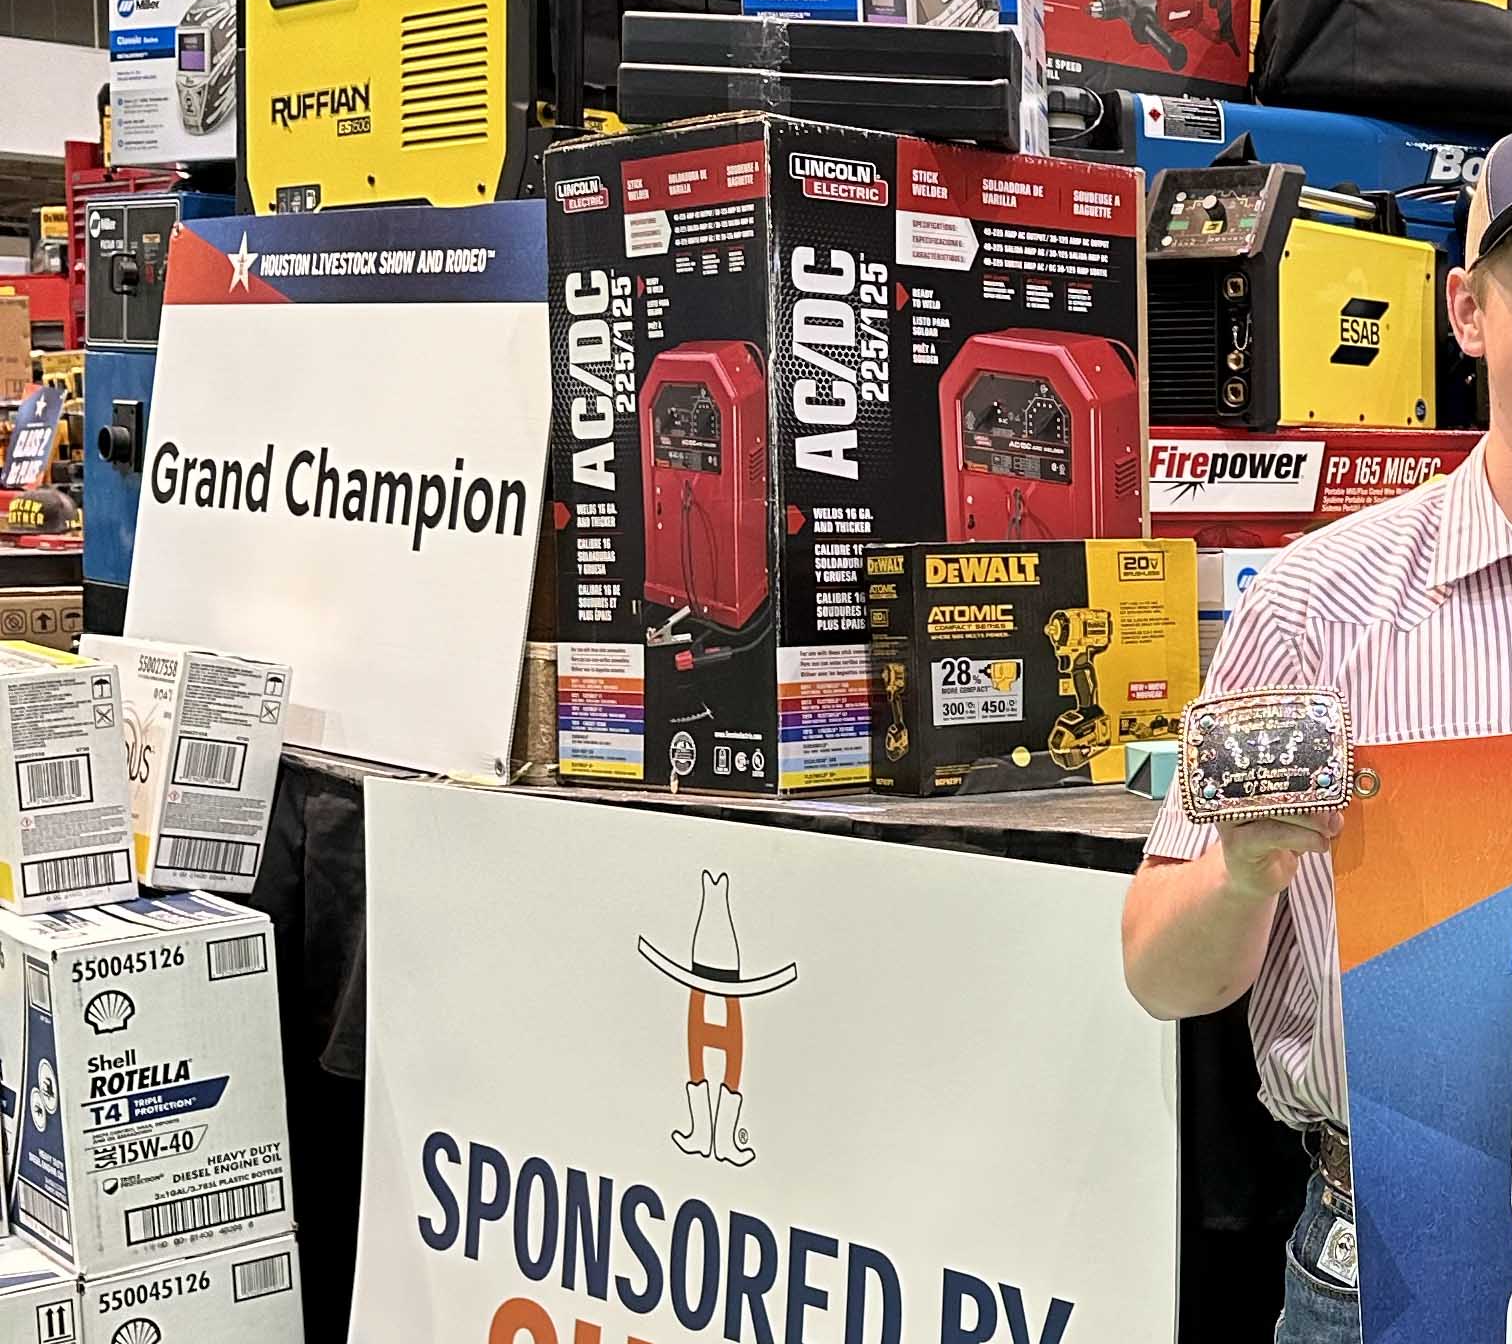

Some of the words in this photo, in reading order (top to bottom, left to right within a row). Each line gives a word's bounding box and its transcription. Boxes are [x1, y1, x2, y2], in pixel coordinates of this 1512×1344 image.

[271, 78, 371, 129] RUFFIAN
[795, 158, 870, 184] LINCOLN
[912, 169, 939, 185] STICK
[558, 180, 598, 197] LINCOLN
[813, 180, 879, 201] ELECTRIC
[912, 183, 948, 200] WELDER
[982, 178, 1031, 197] SOLDADORA
[1032, 186, 1044, 198] DE
[569, 195, 604, 209] ELECTRIC
[982, 192, 1017, 208] VARILLA
[260, 256, 310, 277] HOUSTON
[311, 253, 377, 276] LIVESTOCK
[379, 251, 415, 274] SHOW
[416, 250, 443, 273] AND
[1340, 315, 1380, 344] ESAB
[791, 246, 859, 481] AC/DC
[565, 269, 616, 491] AC/DC
[1150, 445, 1308, 484] Firepower
[1326, 456, 1351, 485] FP
[1354, 456, 1382, 485] 165
[151, 441, 275, 514] Grand
[284, 448, 528, 552] Champion
[813, 507, 844, 522] WELDS
[846, 507, 857, 520] 16
[858, 507, 874, 520] GA.
[813, 521, 833, 533] AND
[834, 521, 871, 534] THICKER
[815, 544, 851, 557] CALIBRE
[867, 557, 904, 574] DEWALT
[926, 556, 1039, 584] DEWALT
[1123, 556, 1159, 571] 20V
[823, 570, 857, 583] GRUESA
[816, 592, 852, 605] CALIBRE
[928, 604, 1014, 623] ATOMIC
[817, 618, 838, 631] PLUS
[943, 702, 965, 716] 300
[982, 700, 1006, 714] 450
[1222, 770, 1255, 787] Grand
[72, 946, 185, 983] 550045126
[88, 1049, 136, 1073] Shell
[90, 1059, 192, 1099] ROTELLA
[134, 1096, 163, 1108] TRIPLE
[91, 1105, 122, 1126] T4
[119, 1130, 194, 1164] 15W-40
[207, 1150, 247, 1166] HEAVY
[250, 1142, 281, 1158] DUTY
[173, 1168, 211, 1184] DIESEL
[214, 1158, 260, 1174] ENGINE
[263, 1153, 282, 1165] OIL
[218, 1175, 250, 1189] PLASTIC
[99, 1271, 210, 1314] 550045126
